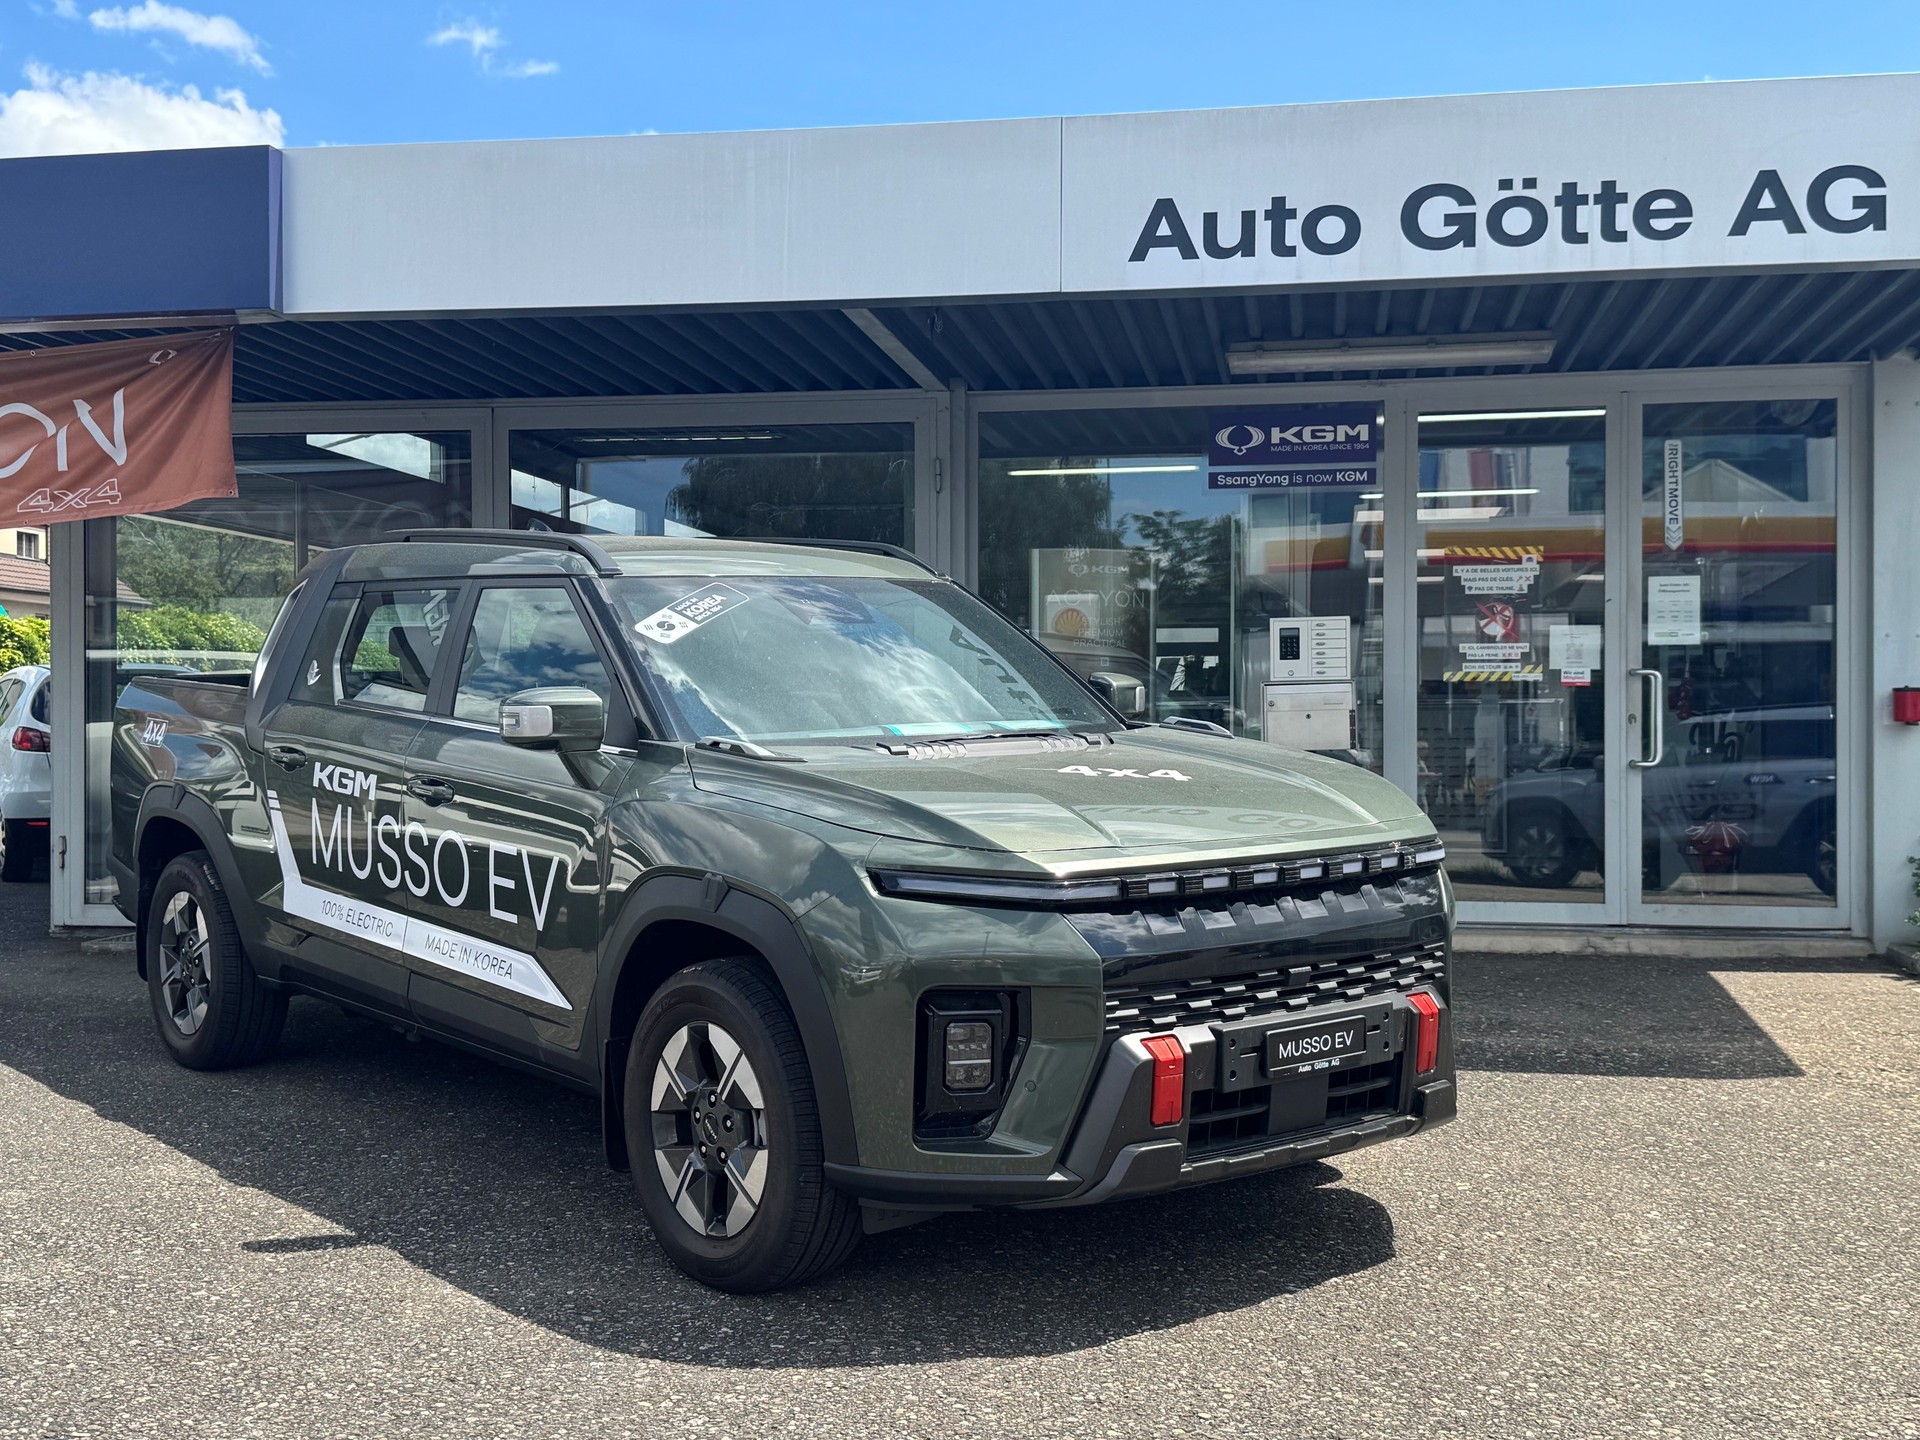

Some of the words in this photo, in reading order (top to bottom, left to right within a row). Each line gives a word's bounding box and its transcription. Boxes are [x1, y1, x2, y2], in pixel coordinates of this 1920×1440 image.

[1128, 196, 1361, 262] Auto
[1401, 178, 1693, 251] Götte
[1728, 165, 1887, 237] AG
[1271, 424, 1370, 444] KGM
[1217, 473, 1289, 487] SsangYong
[1293, 473, 1303, 483] is
[1307, 473, 1333, 483] now
[1336, 471, 1368, 482] KGM
[1091, 565, 1129, 574] KGM
[682, 594, 727, 617] KOREA
[1073, 639, 1126, 648] PRACTICAL
[1078, 628, 1123, 637] PREMIUM
[312, 762, 377, 801] KGM
[311, 797, 470, 908] MUSSO
[488, 841, 560, 931] EV
[321, 899, 344, 921] 100%
[345, 907, 394, 938] ELECTRIC
[424, 934, 458, 960] MADE
[458, 944, 472, 963] IN
[473, 946, 513, 980] KOREA
[1279, 1035, 1331, 1059] MUSSO
[1335, 1030, 1354, 1048] EV
[1298, 1064, 1311, 1073] Auto
[1331, 1058, 1340, 1067] AG
